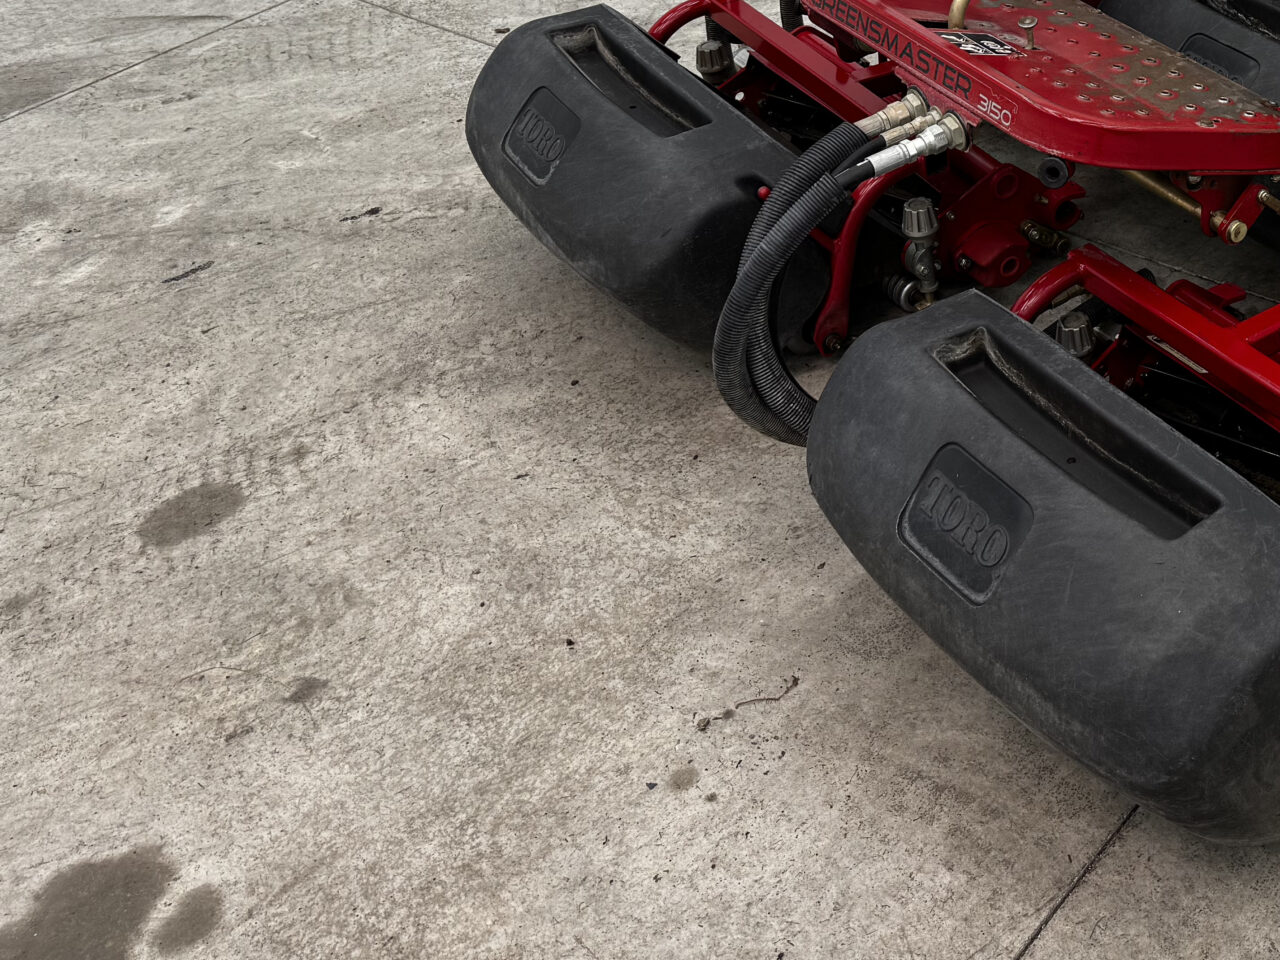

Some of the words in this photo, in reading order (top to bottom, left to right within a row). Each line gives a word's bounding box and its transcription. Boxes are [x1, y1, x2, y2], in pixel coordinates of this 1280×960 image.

[518, 108, 566, 163] TORO
[977, 93, 1012, 127] 3150
[919, 473, 1010, 569] TORO
